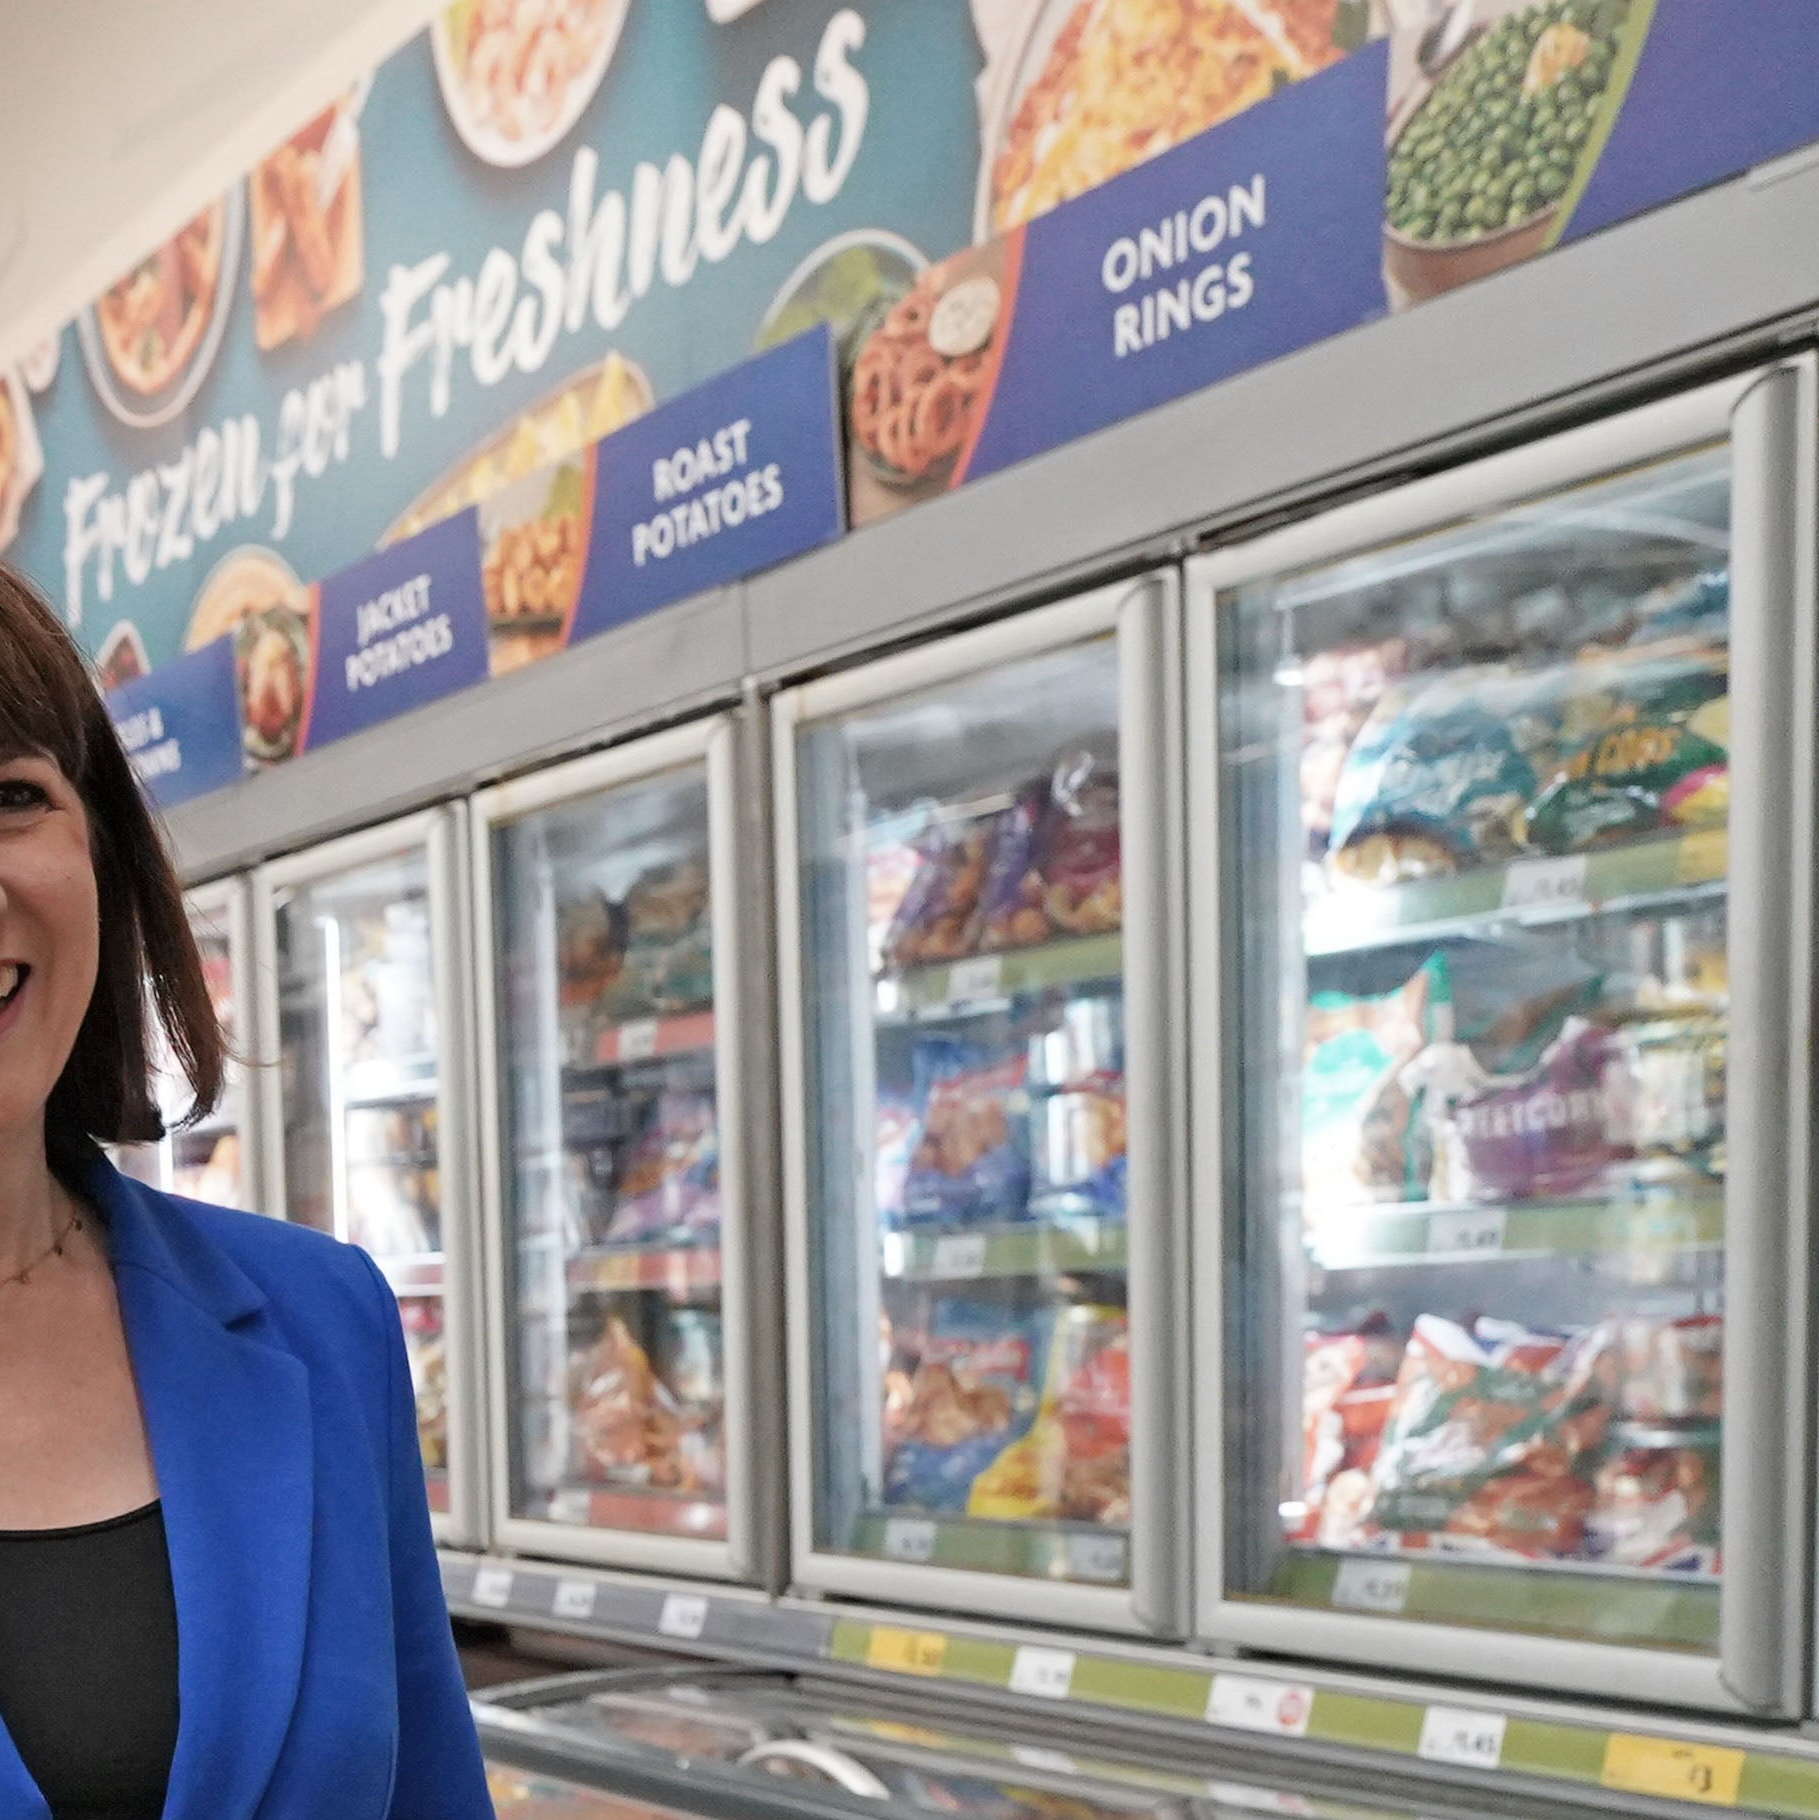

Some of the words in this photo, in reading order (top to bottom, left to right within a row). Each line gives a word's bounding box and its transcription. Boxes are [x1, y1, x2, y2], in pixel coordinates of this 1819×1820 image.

[1101, 173, 1266, 293] ONION
[63, 412, 261, 630] Frozen
[269, 362, 366, 541] for
[376, 9, 869, 458] Freshness
[1114, 251, 1254, 358] RINGS
[653, 418, 752, 503] ROAST
[631, 462, 785, 568] POTATOES
[344, 612, 454, 693] POTATOES
[355, 573, 433, 647] JACKET
